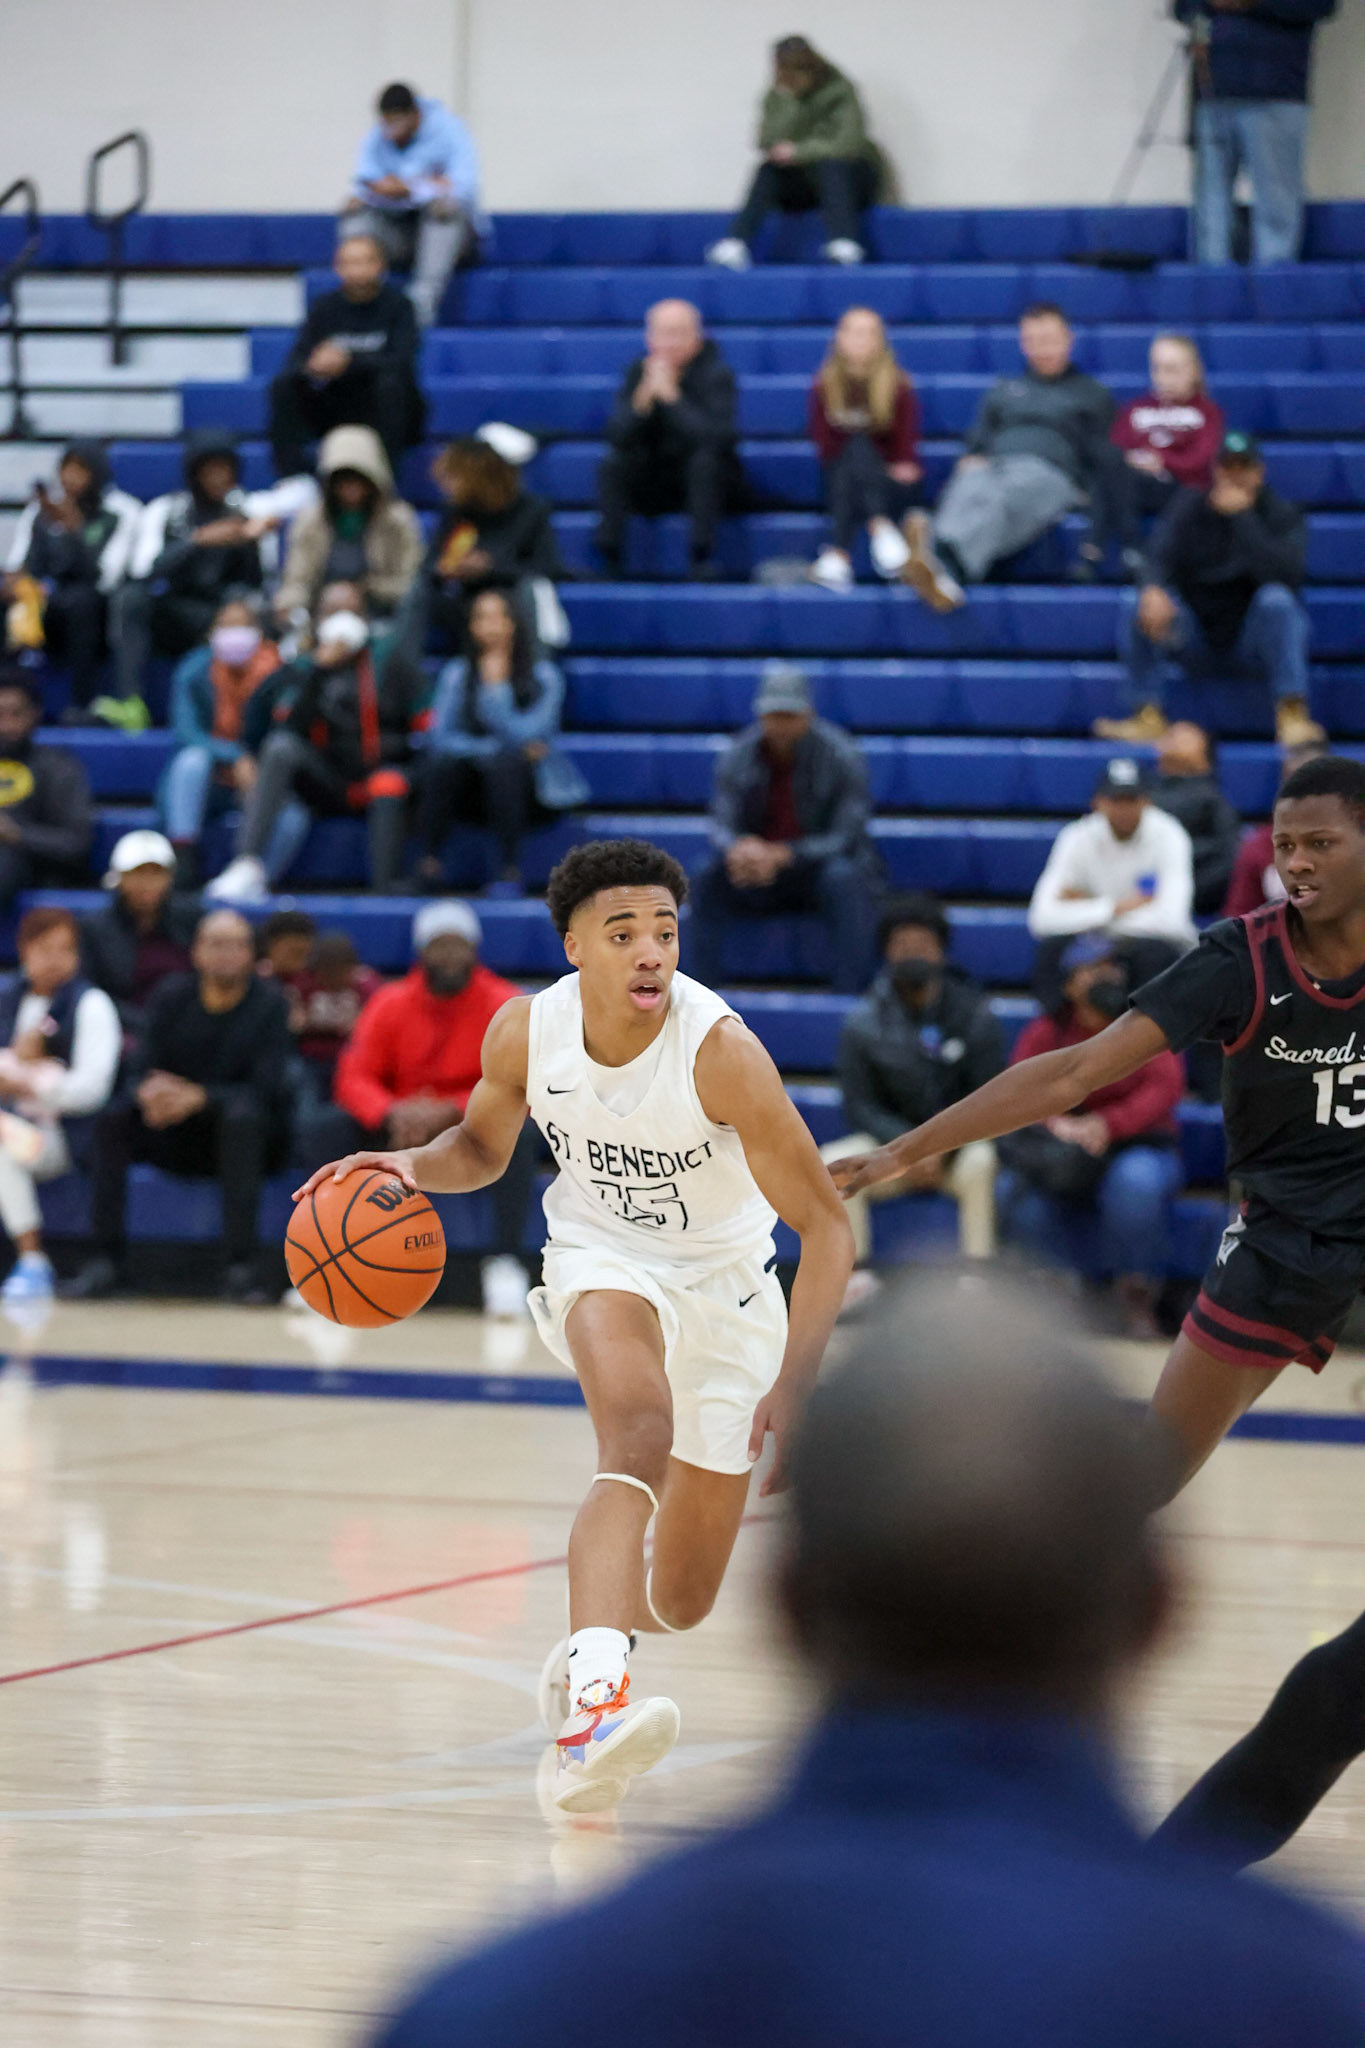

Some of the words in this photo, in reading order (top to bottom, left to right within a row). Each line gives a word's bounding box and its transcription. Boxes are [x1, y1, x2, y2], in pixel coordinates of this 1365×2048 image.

[1264, 1031, 1356, 1064] Sacred
[1312, 1062, 1365, 1128] 13
[546, 1121, 582, 1163] ST.
[586, 1138, 713, 1178] BENEDICT
[404, 1230, 442, 1250] EVOLU
